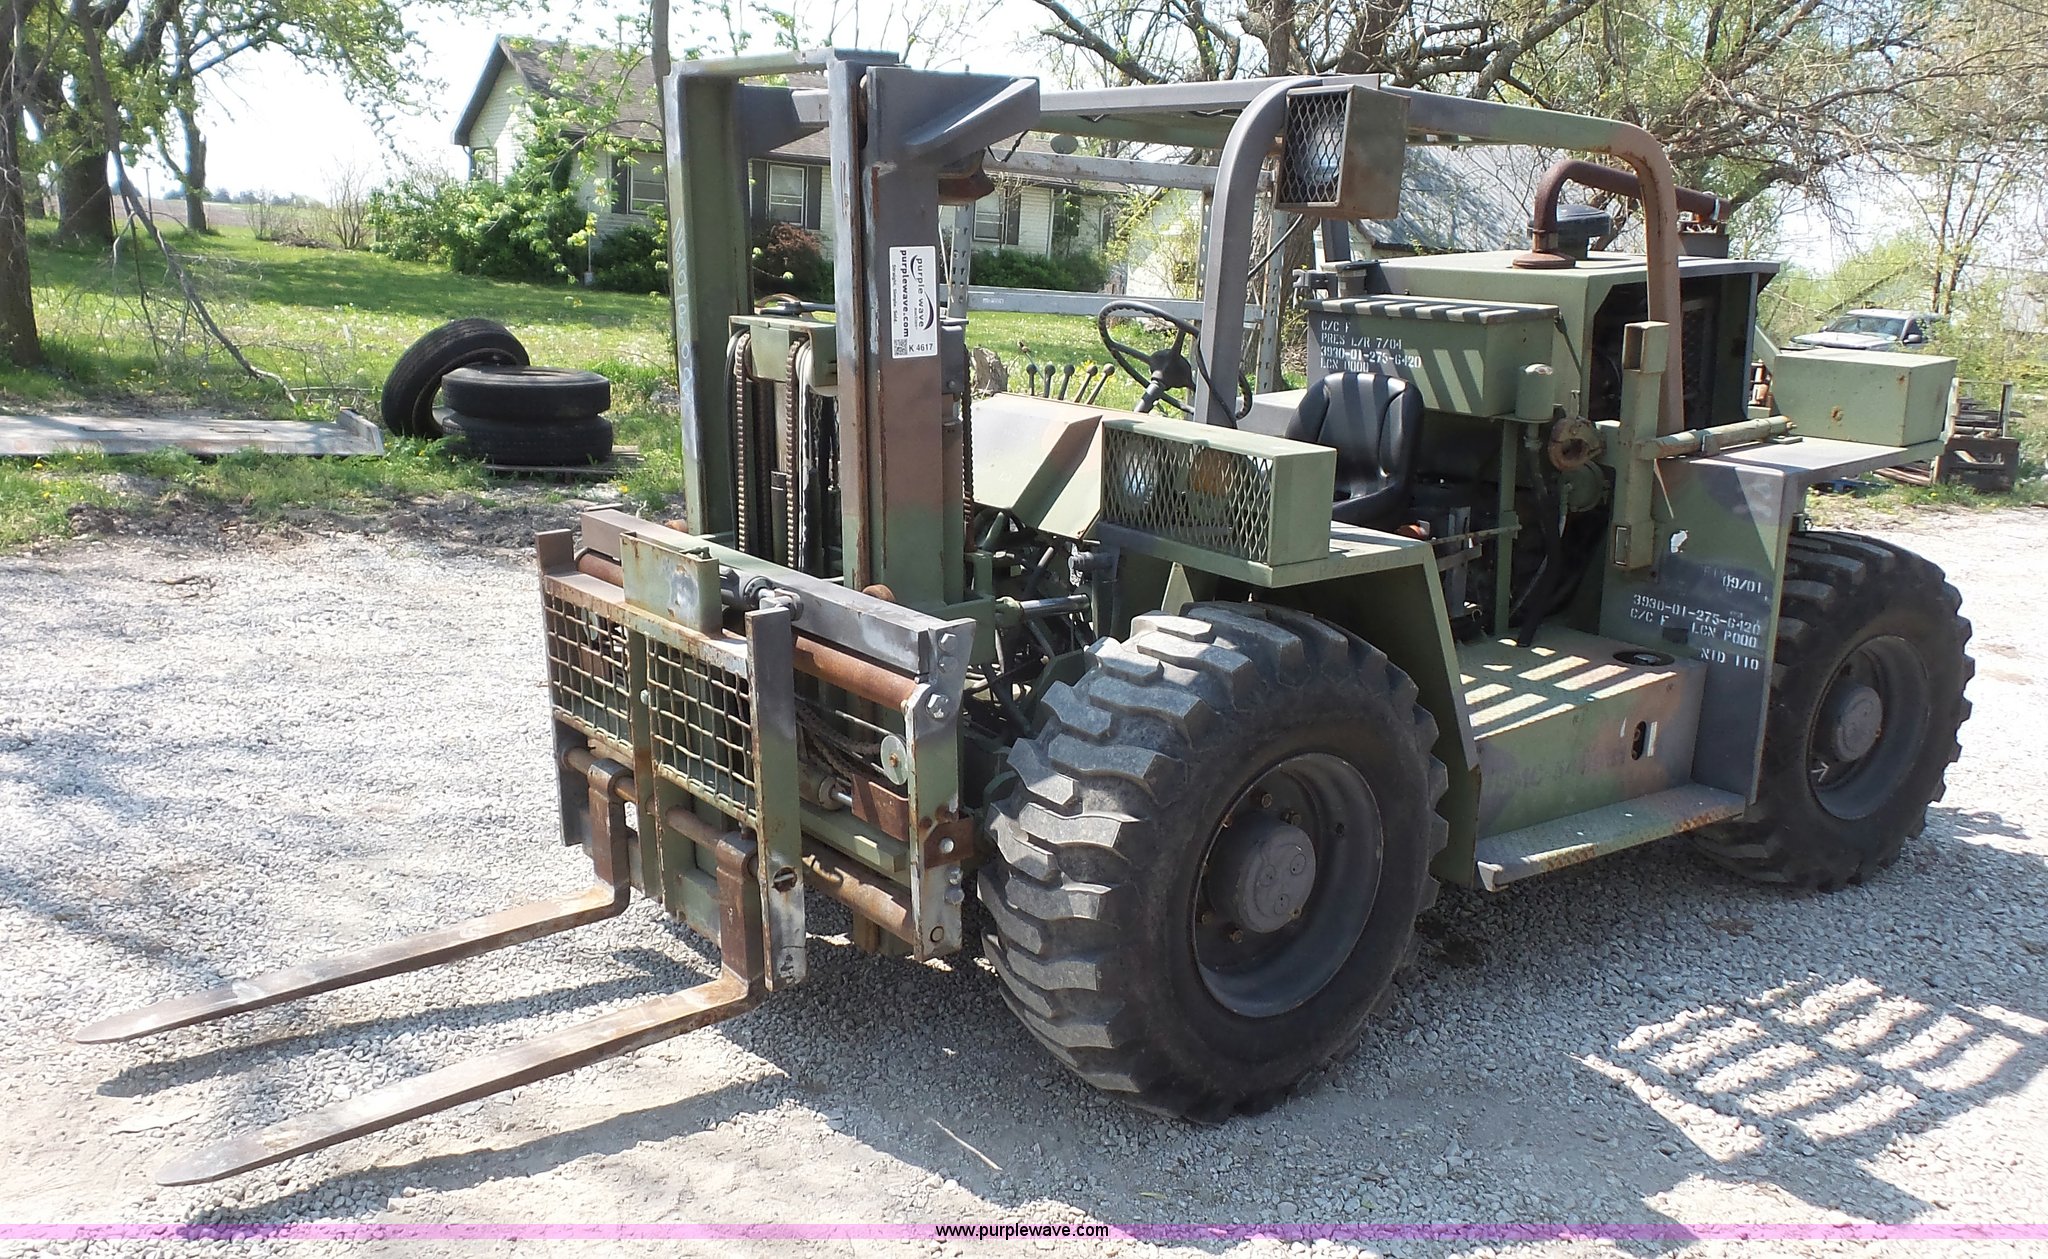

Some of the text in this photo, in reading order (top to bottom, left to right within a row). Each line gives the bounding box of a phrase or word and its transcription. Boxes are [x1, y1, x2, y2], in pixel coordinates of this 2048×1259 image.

[916, 258, 925, 294] purple
[900, 250, 909, 337] purplewave.com
[1321, 320, 1340, 332] C/C
[908, 343, 934, 353] K 4617
[1321, 332, 1402, 350] PRES L/R 7/04
[1630, 607, 1654, 623] C/C
[1660, 614, 1670, 626] F
[1691, 622, 1717, 639] LCN
[1735, 655, 1759, 671] 110
